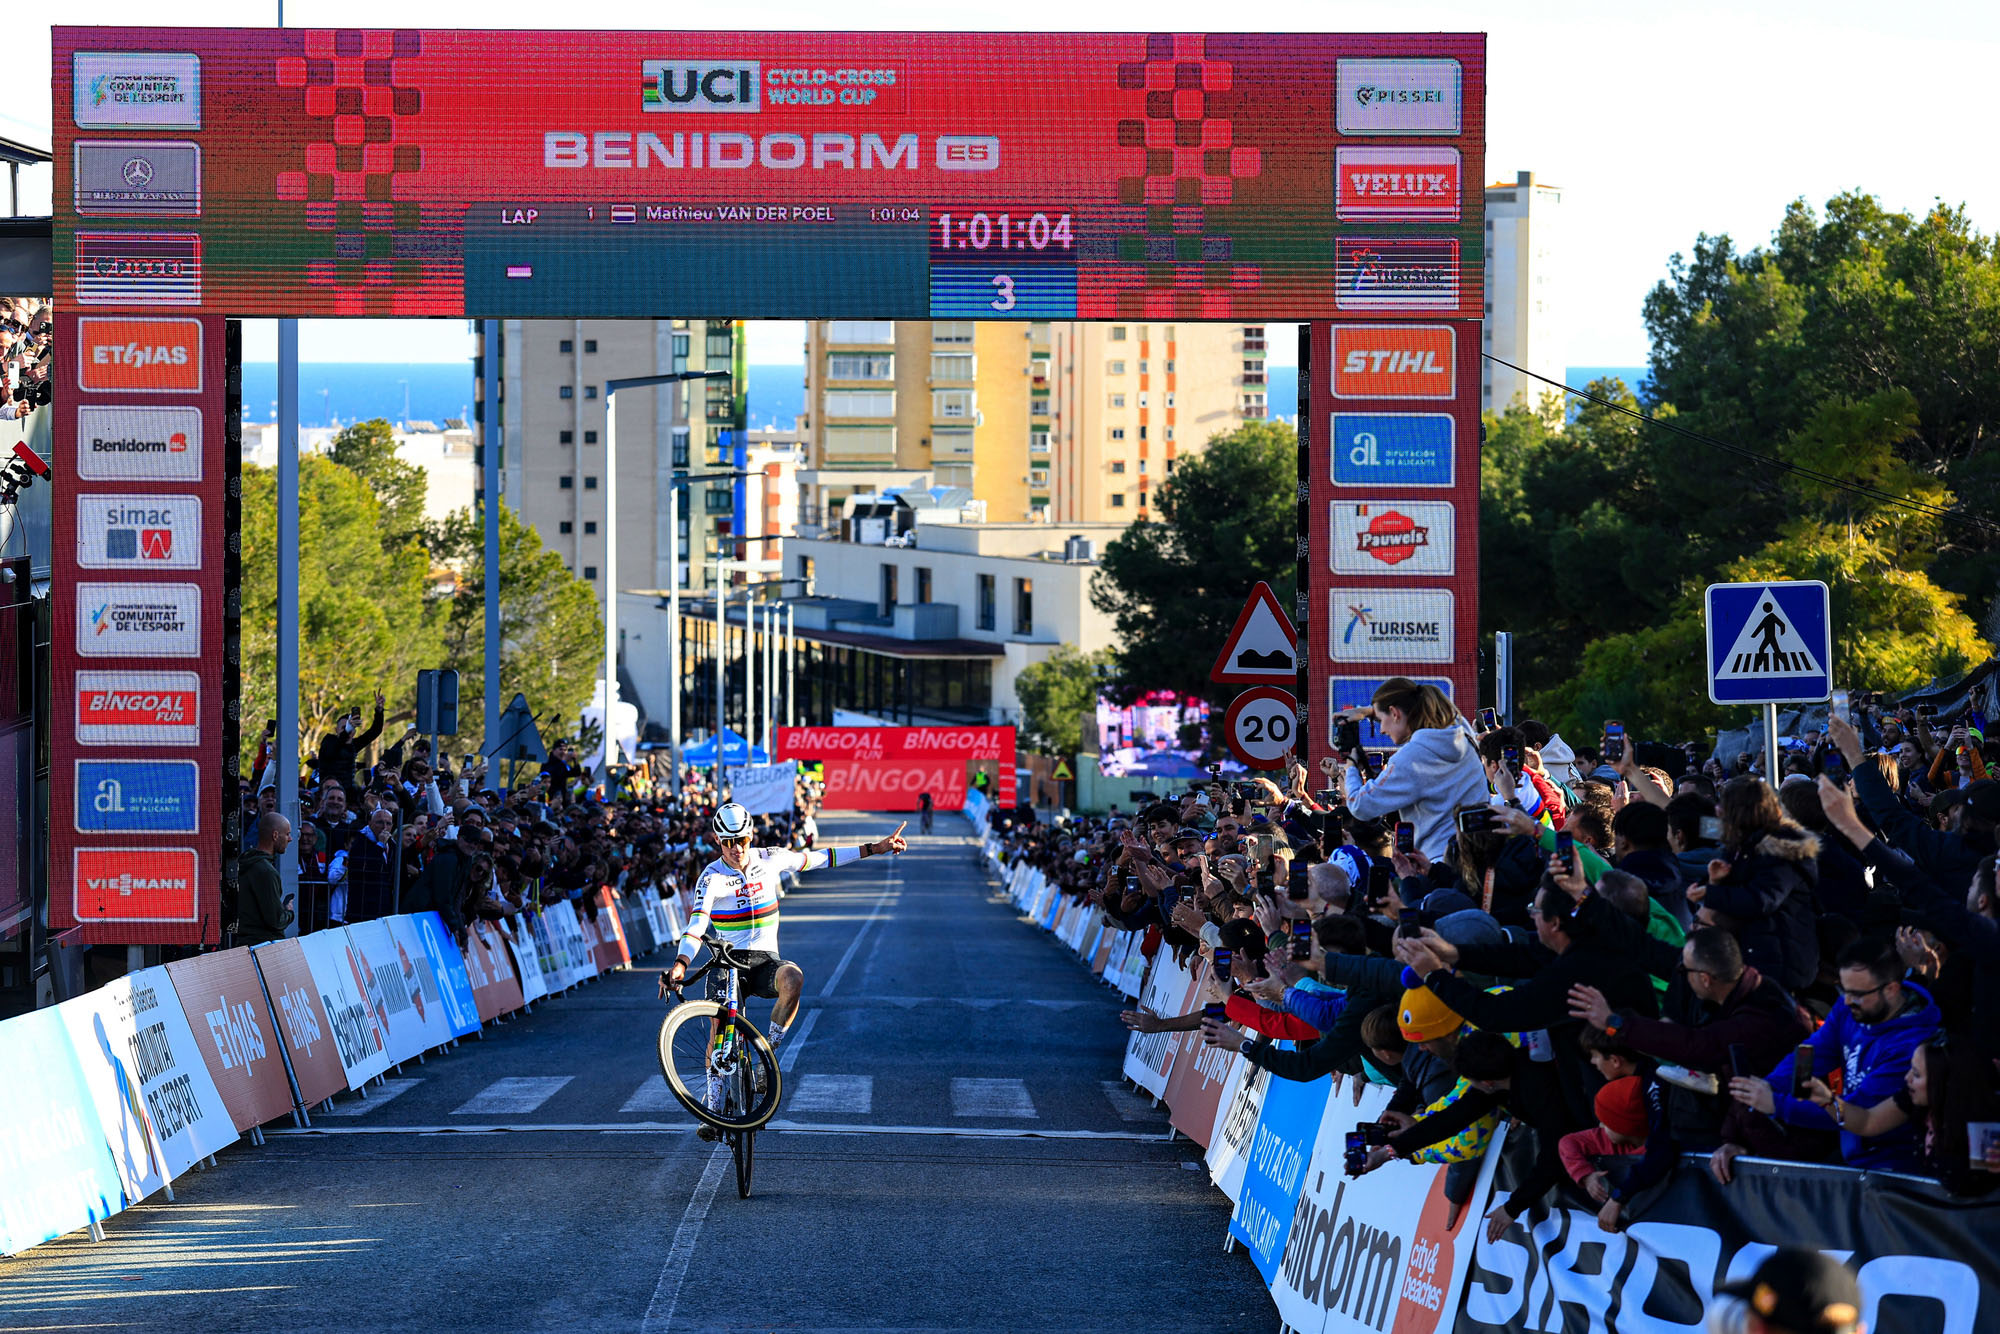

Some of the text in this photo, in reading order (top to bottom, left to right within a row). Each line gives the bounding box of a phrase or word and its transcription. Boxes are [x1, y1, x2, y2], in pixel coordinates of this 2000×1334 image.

[767, 68, 896, 86] CYCLO-CROSS
[662, 69, 749, 103] UCI
[767, 88, 877, 105] WORLD CUP
[1377, 90, 1441, 103] PISSEI
[544, 131, 918, 169] BENIDORM
[950, 144, 988, 159] ES
[1350, 173, 1446, 196] VELUX
[502, 208, 538, 224] LAP
[646, 205, 713, 221] Mathieu
[717, 206, 751, 221] VAN
[755, 206, 787, 221] DER
[792, 206, 836, 222] POEL
[870, 208, 920, 221] 1:01:04
[938, 213, 1074, 249] 1:01:04
[990, 274, 1016, 311] 3
[1343, 350, 1444, 373] STIHL
[92, 438, 167, 452] Benidorm
[107, 504, 172, 525] simac
[1362, 529, 1425, 547] Pauwels
[111, 611, 177, 621] COMUNITAT
[116, 622, 185, 632] DE L'ESPORT
[1369, 622, 1439, 635] TURISME
[155, 711, 184, 722] FUN
[1242, 715, 1290, 742] 20
[854, 750, 883, 760] FUN
[972, 750, 1000, 759] FUN
[728, 878, 744, 887] UCI
[128, 1021, 176, 1086] COMUNITAT
[1403, 1269, 1443, 1312] beaches
